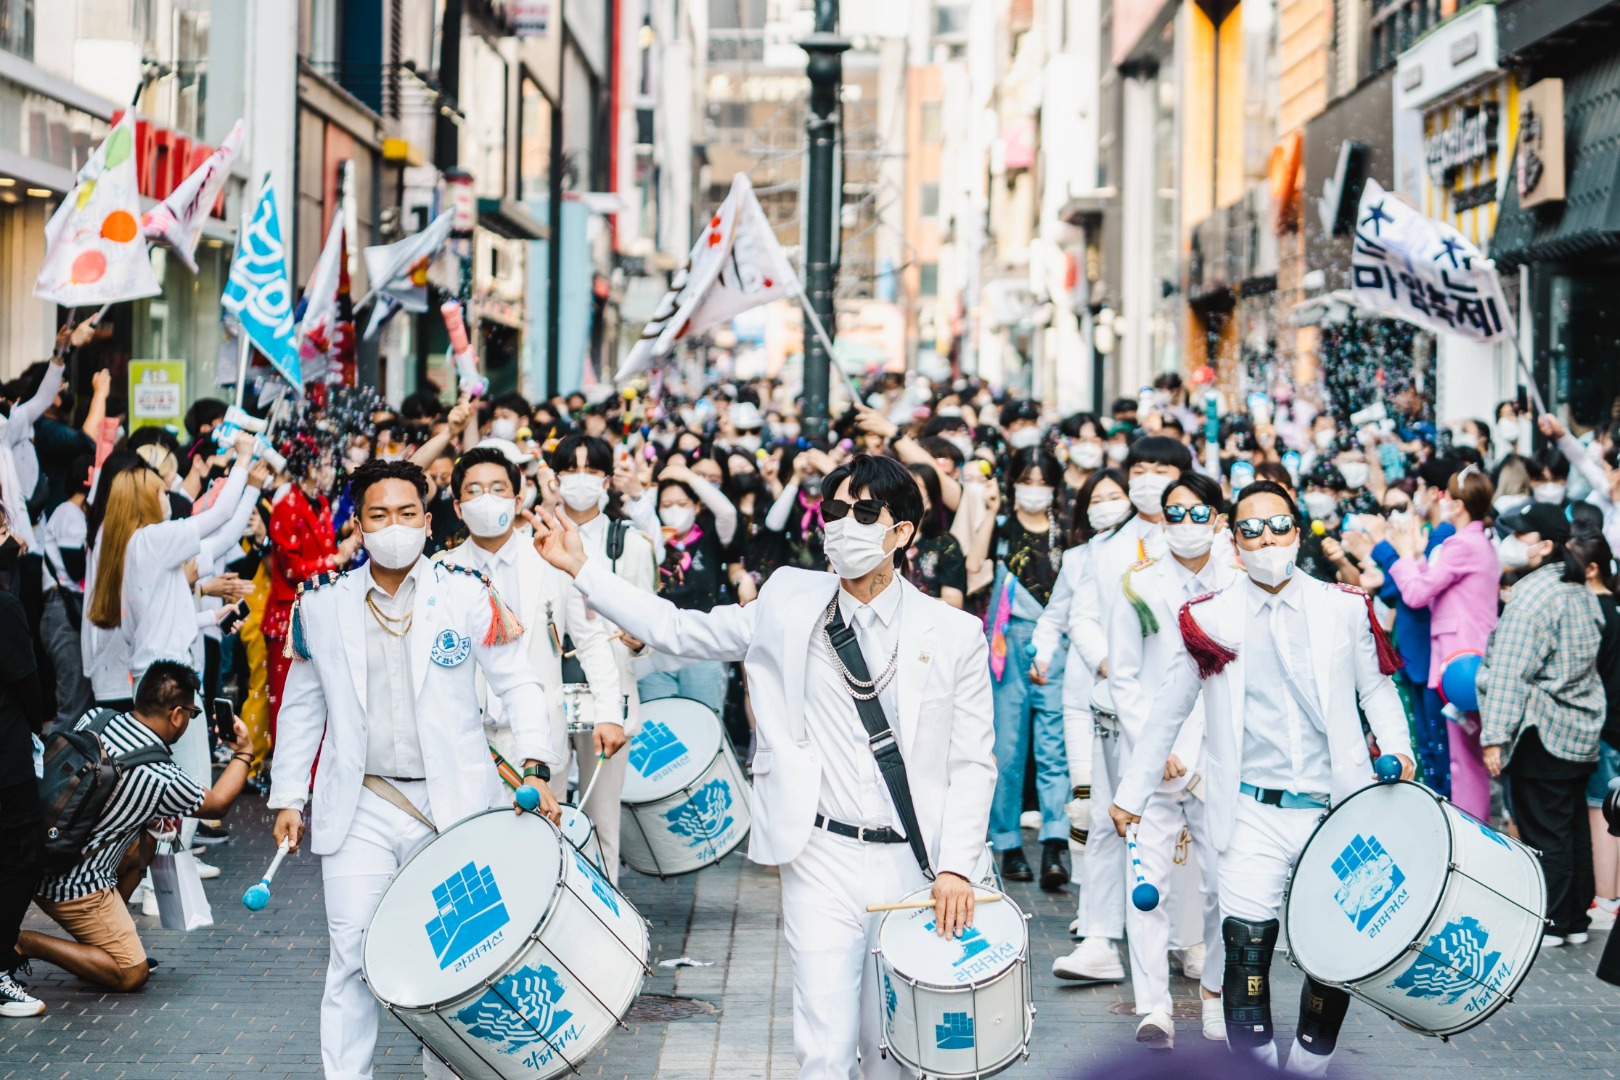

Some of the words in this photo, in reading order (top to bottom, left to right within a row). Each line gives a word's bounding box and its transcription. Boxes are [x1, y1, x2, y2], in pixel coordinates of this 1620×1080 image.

[1367, 889, 1411, 940] 라퍼커션
[453, 929, 505, 973] 라퍼커션
[953, 942, 1019, 983] 라퍼커션
[1463, 957, 1516, 1013] 라퍼커션
[521, 1023, 587, 1072] 라퍼커션
